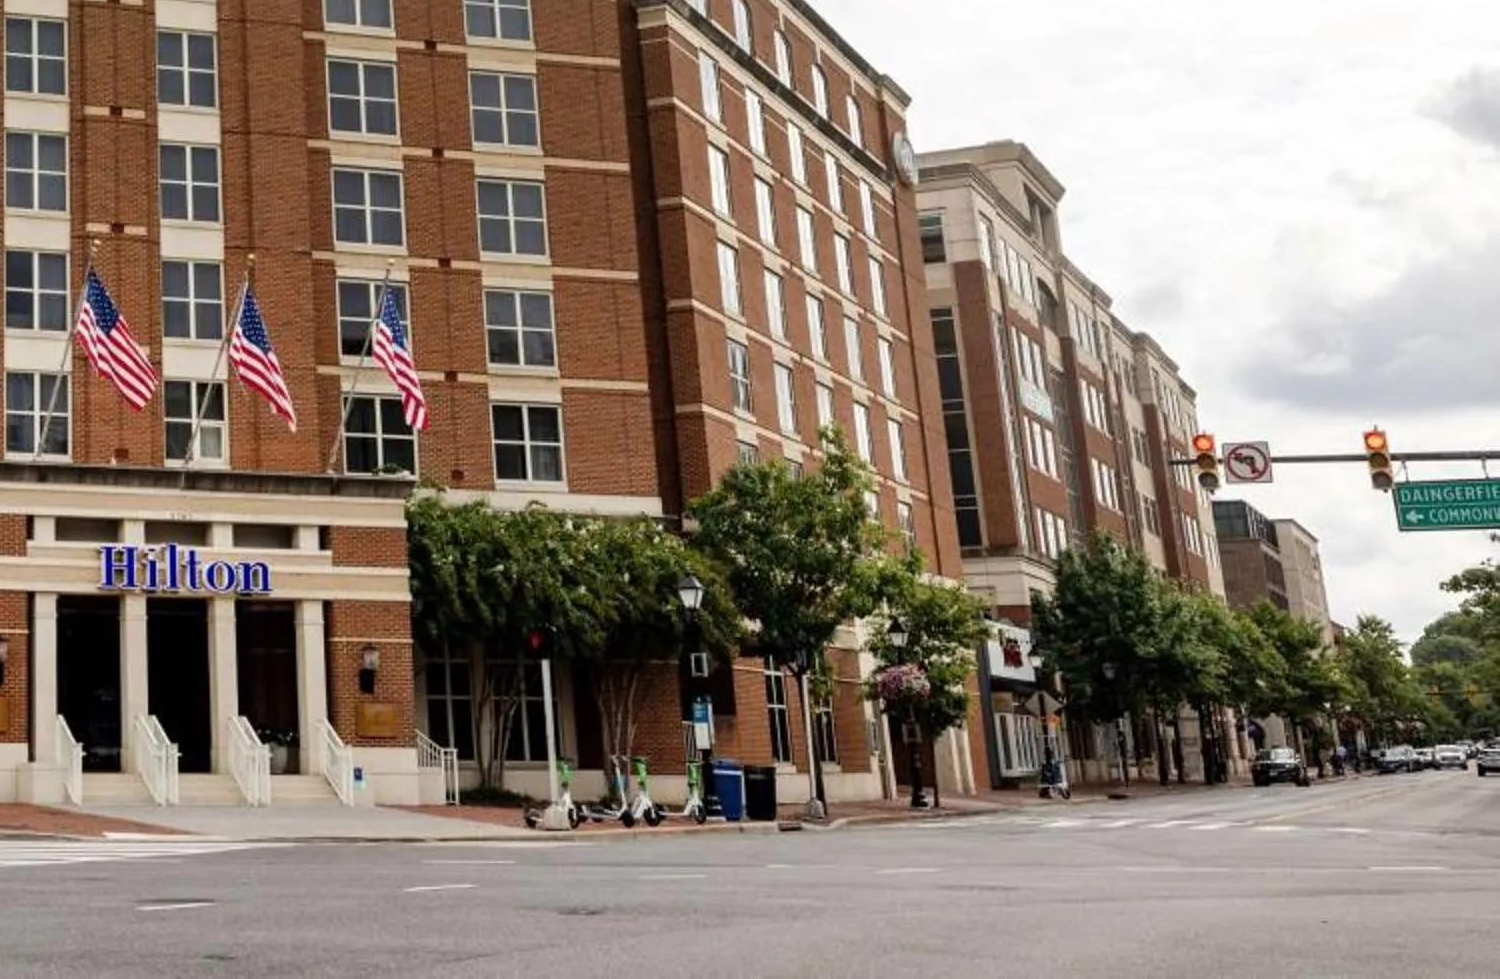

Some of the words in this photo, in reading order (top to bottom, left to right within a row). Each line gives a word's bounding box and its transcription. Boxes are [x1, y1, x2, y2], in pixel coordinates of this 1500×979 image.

[1401, 484, 1500, 503] DAINGERFIE
[1428, 507, 1500, 524] COMMONW
[99, 542, 272, 594] Hilton
